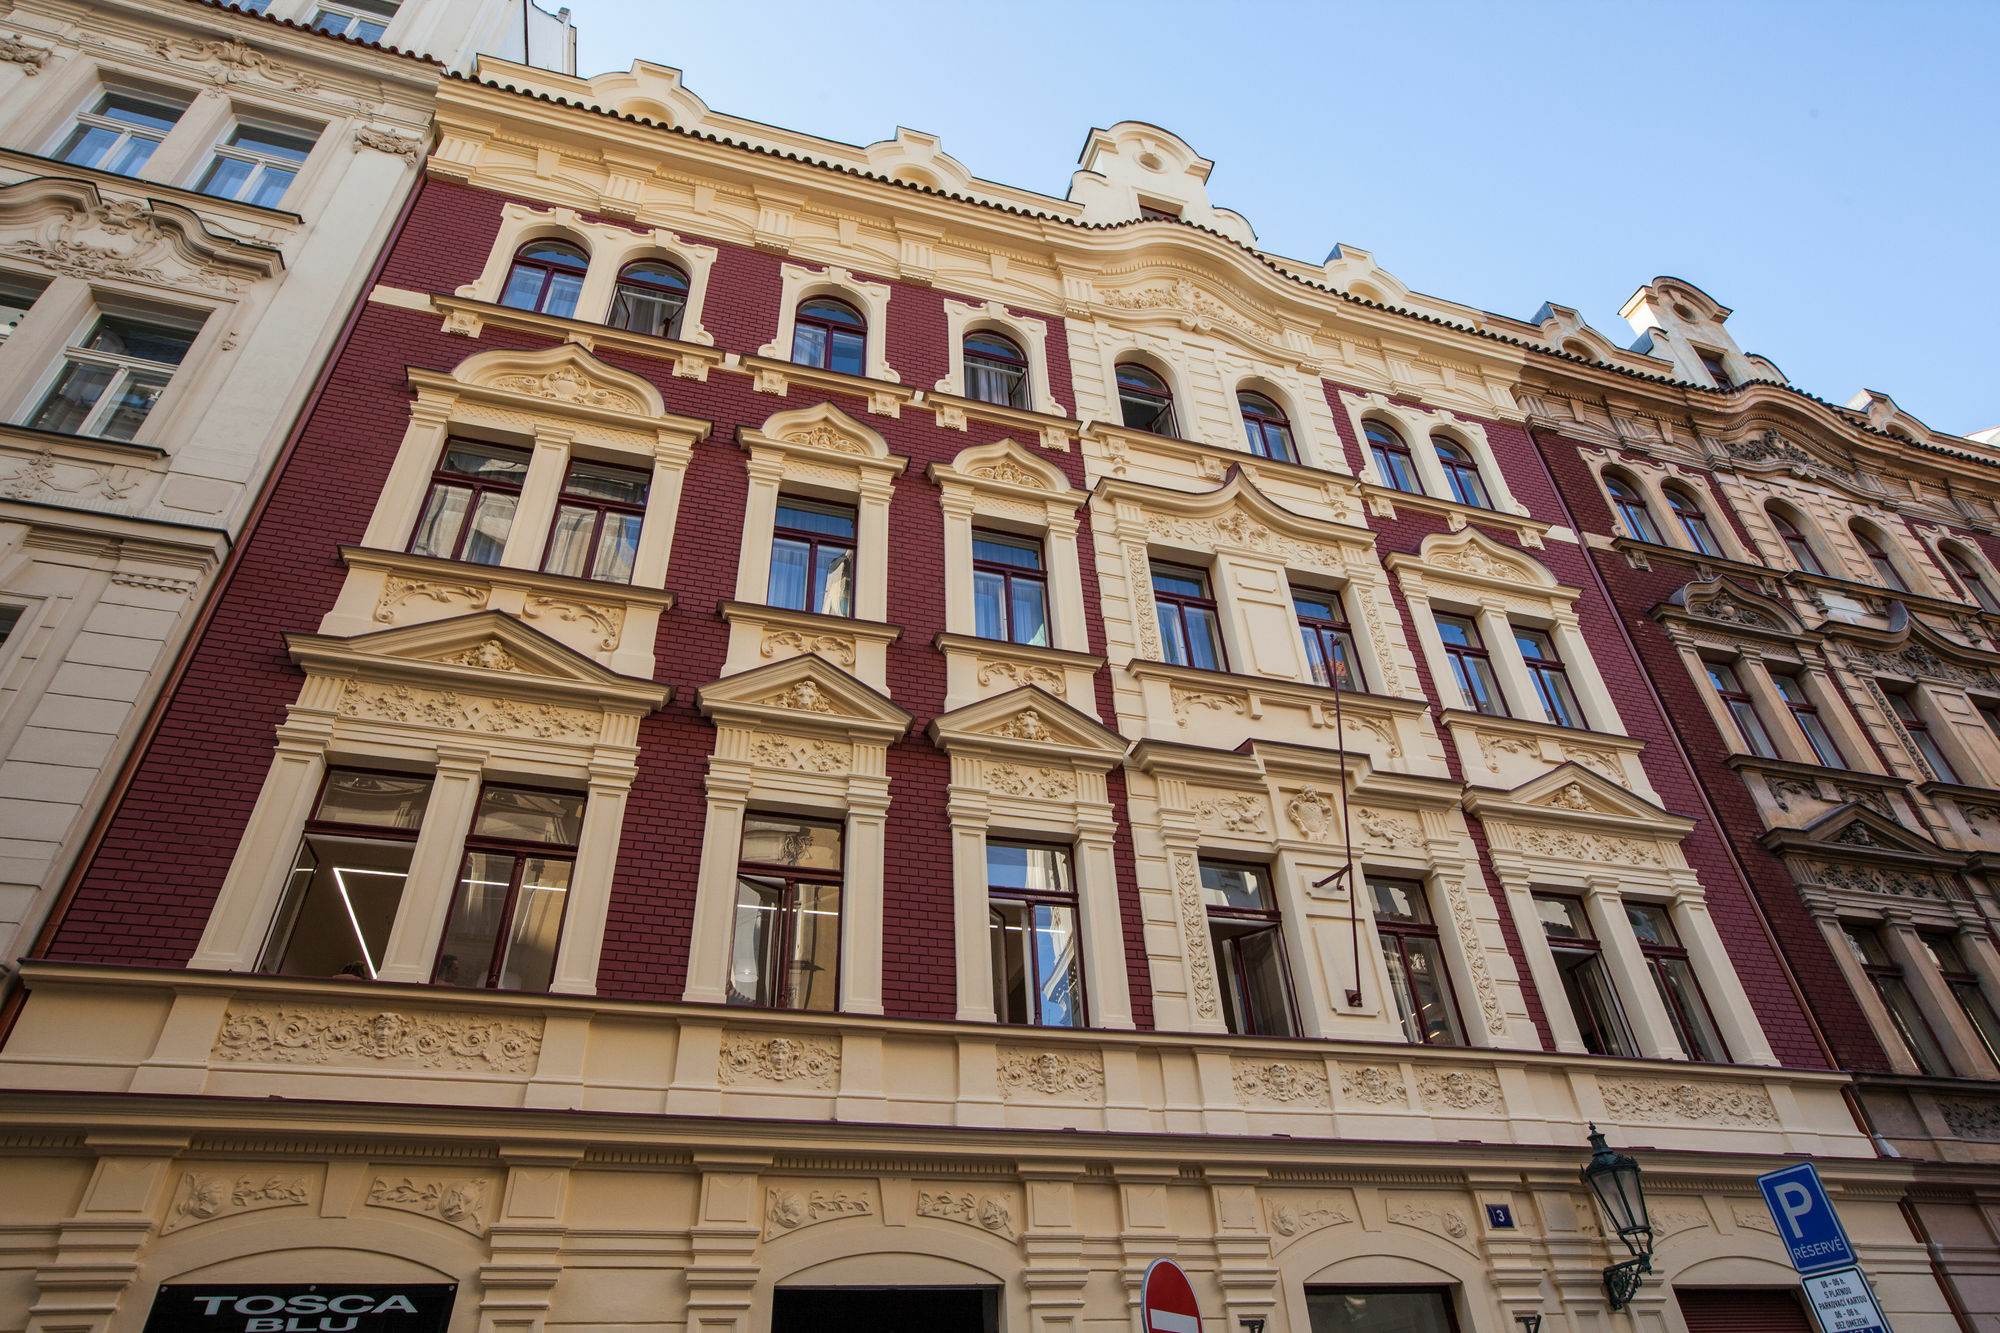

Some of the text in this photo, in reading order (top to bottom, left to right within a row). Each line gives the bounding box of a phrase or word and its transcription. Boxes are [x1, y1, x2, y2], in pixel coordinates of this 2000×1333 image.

[1496, 1209, 1505, 1223] 3
[1774, 1182, 1813, 1238] P
[1793, 1236, 1844, 1259] RÉSERVÉ
[193, 1294, 418, 1316] TOSCA
[245, 1317, 358, 1333] BLU
